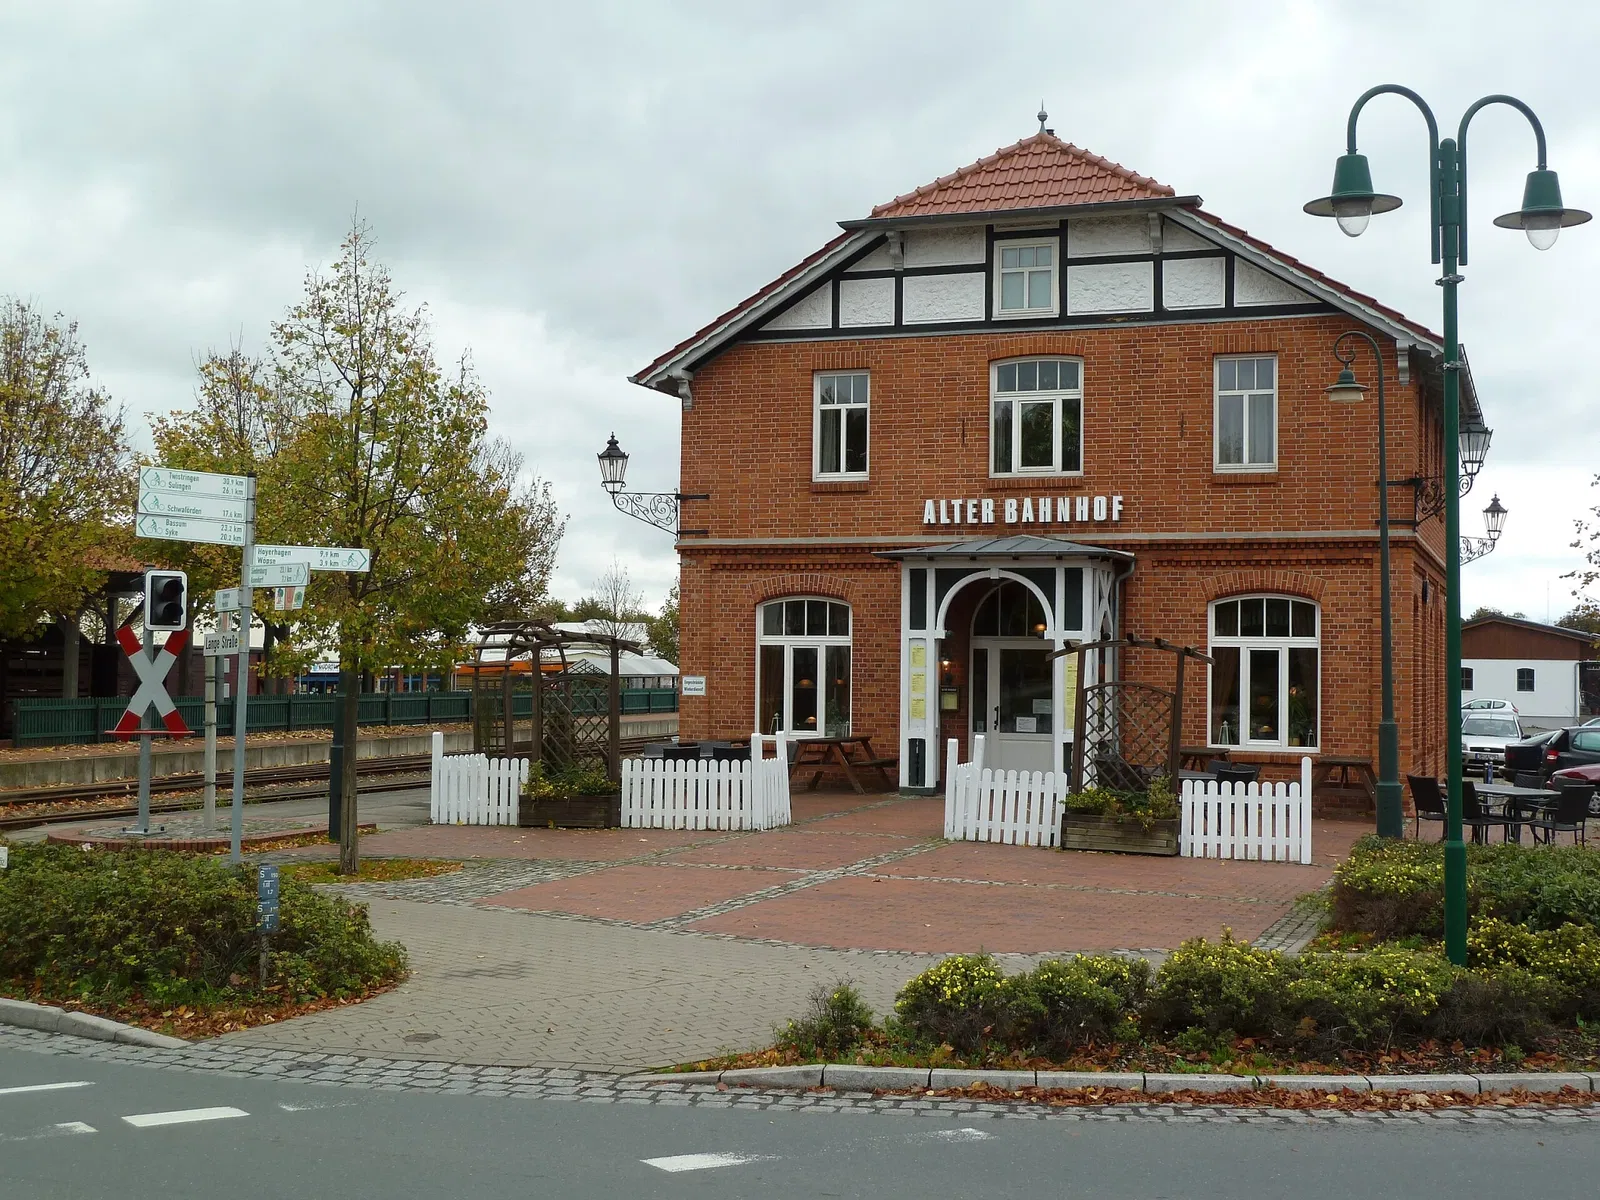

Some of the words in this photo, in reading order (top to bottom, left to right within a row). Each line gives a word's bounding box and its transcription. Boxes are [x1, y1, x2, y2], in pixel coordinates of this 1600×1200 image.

[169, 472, 200, 482] Twistringen
[168, 482, 191, 491] Sulingen
[923, 498, 994, 524] ALTER
[1005, 495, 1124, 524] BAHNHOF
[166, 519, 187, 527] Bassum
[165, 528, 178, 536] Syke
[233, 534, 242, 542] km
[257, 548, 292, 557] Hoyerhagen
[206, 637, 220, 652] Lange
[222, 634, 238, 649] Straße
[260, 870, 265, 878] S
[257, 904, 263, 912] S
